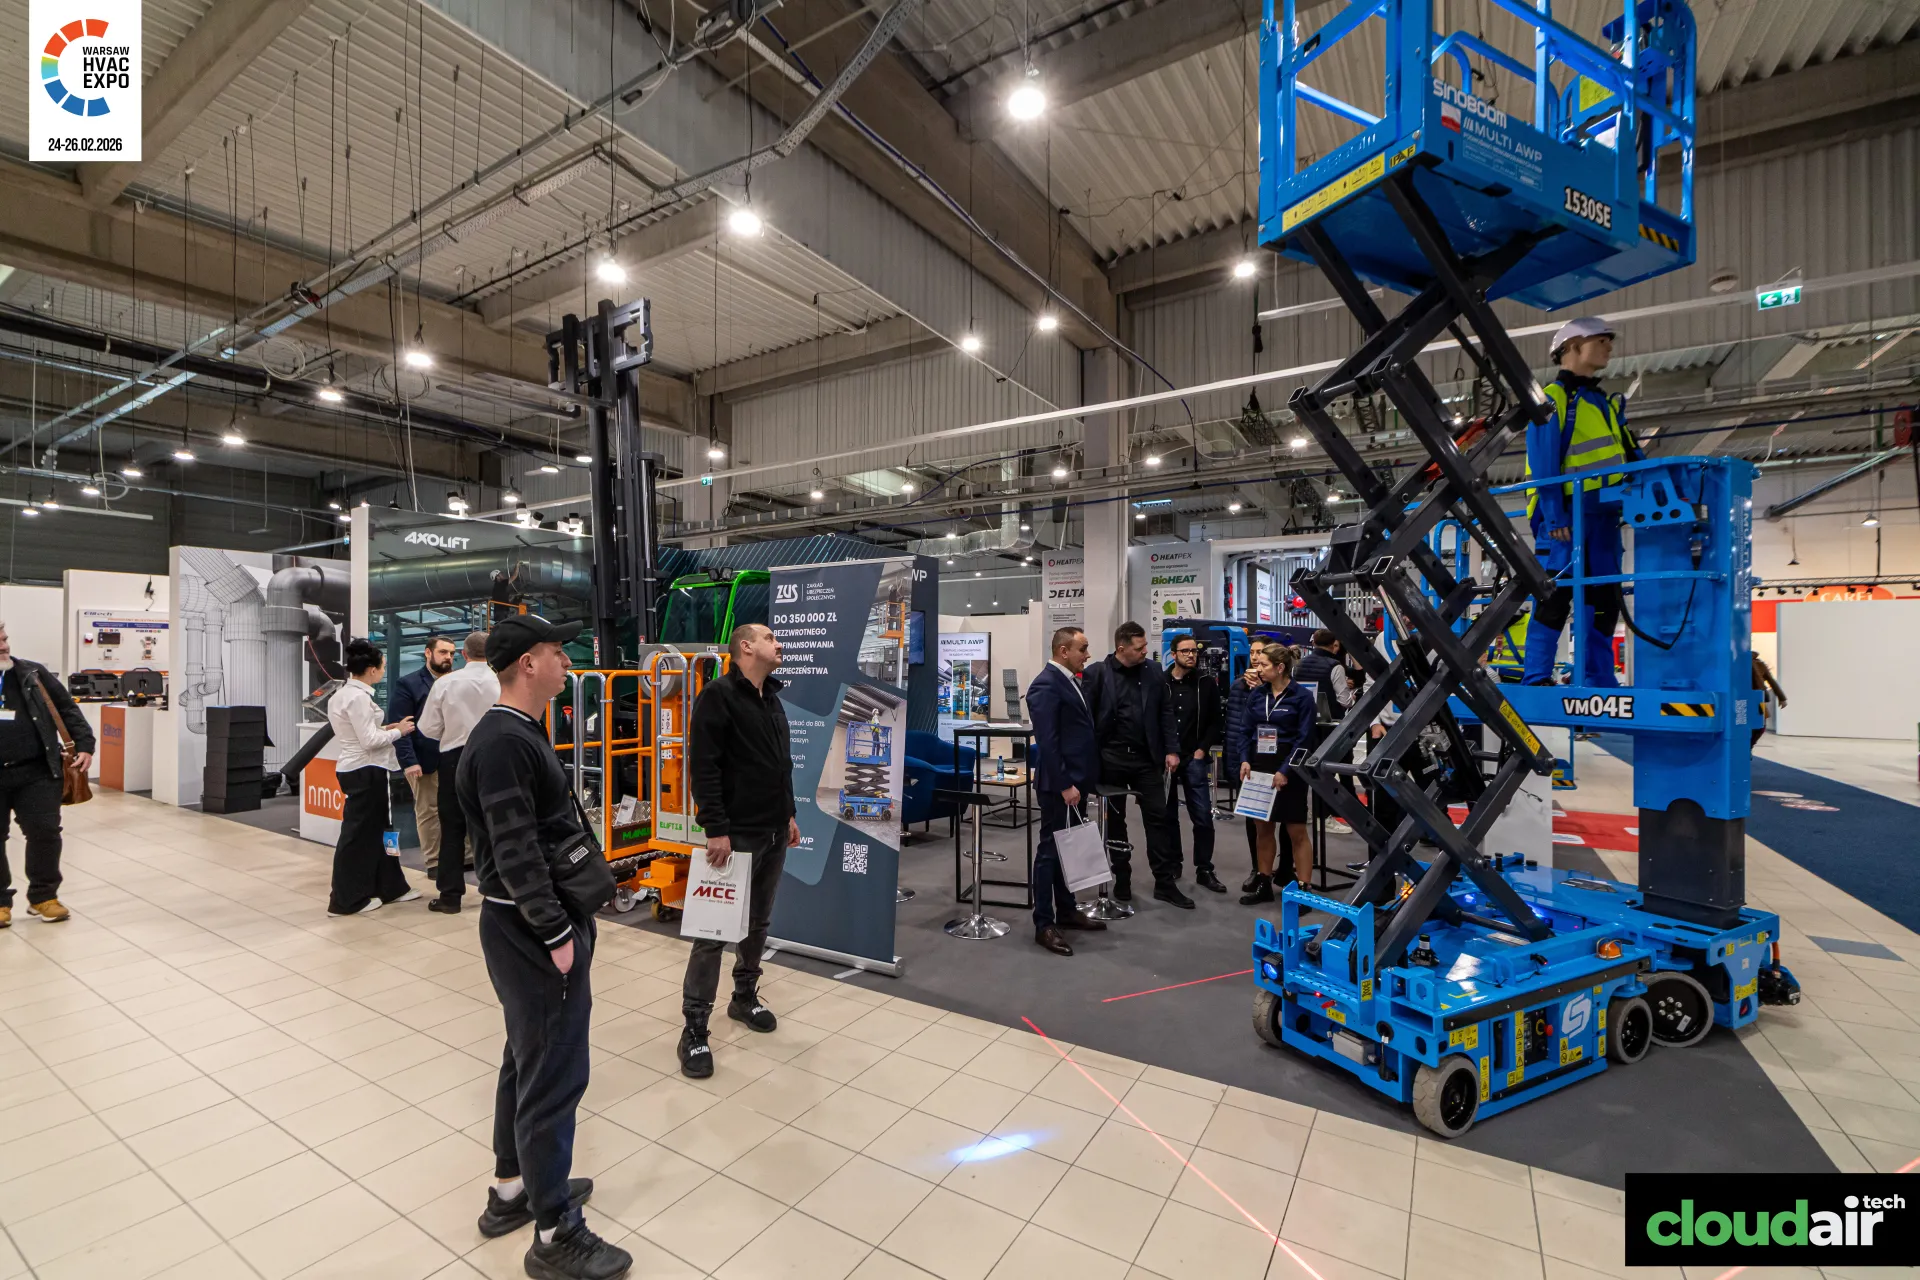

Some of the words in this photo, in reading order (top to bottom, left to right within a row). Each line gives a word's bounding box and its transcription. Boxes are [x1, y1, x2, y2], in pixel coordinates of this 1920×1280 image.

[1515, 142, 1543, 162] AWP
[1564, 187, 1612, 229] 1530SE
[404, 531, 470, 550] AXOLIFT
[1160, 553, 1192, 561] HEATPEX
[1151, 574, 1198, 586] BioHEAT
[775, 584, 799, 604] ZUS
[1048, 588, 1084, 598] DELTA
[774, 614, 788, 625] DO
[788, 613, 806, 624] 350
[807, 612, 826, 623] 000
[826, 611, 838, 622] ZŁ
[773, 628, 827, 637] BEZZWROTNEGO
[779, 641, 835, 649] FINANSOWANIA
[782, 653, 814, 663] POPRAWĘ
[1562, 695, 1634, 719] VM04E
[308, 785, 342, 811] nmc
[570, 847, 588, 863] PUMA
[692, 886, 736, 900] MCC
